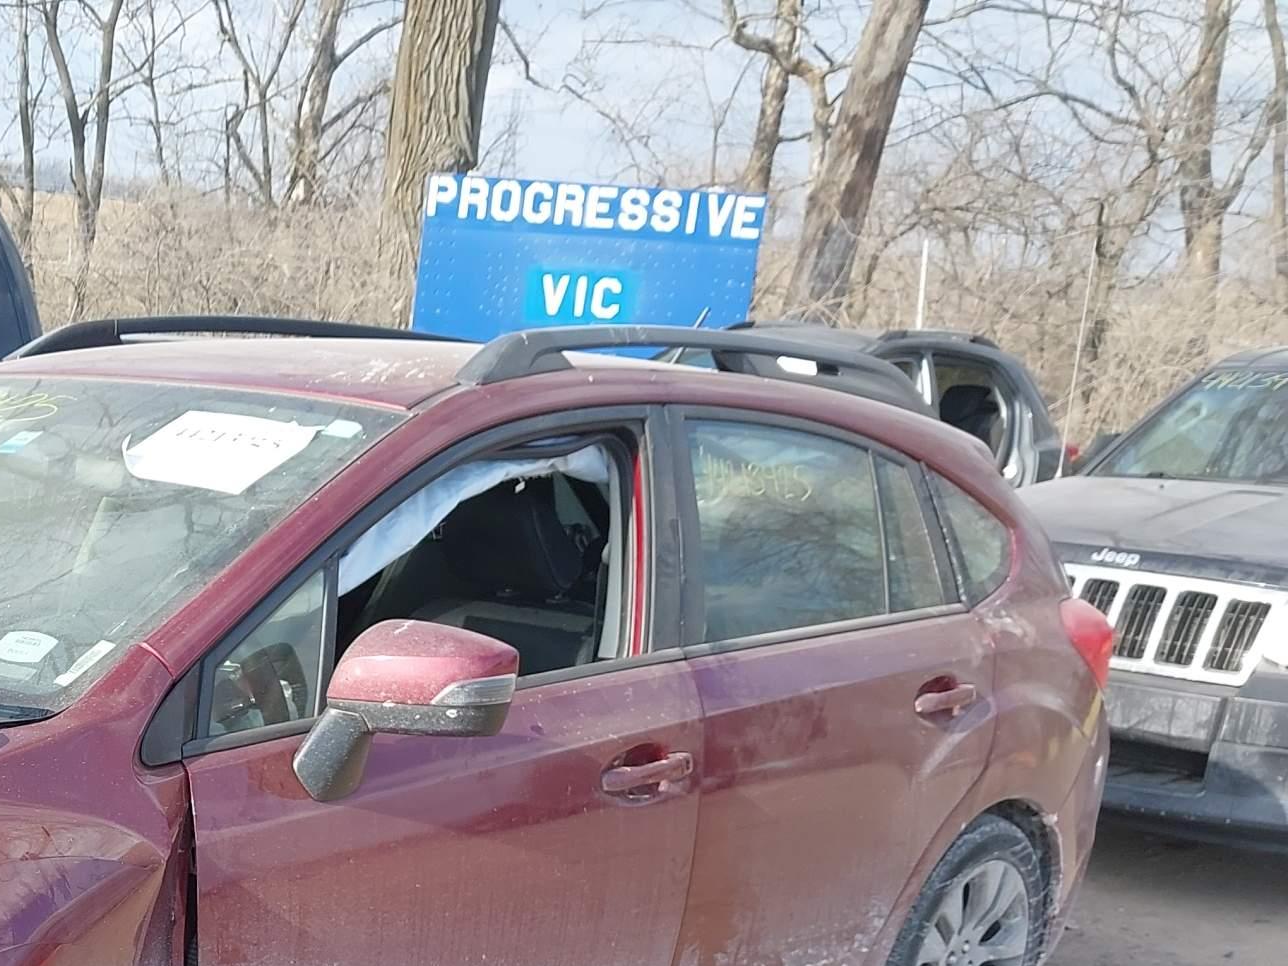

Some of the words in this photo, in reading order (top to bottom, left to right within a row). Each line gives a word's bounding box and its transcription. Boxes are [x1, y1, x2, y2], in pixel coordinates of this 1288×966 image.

[426, 174, 767, 240] PROGRESSIVE
[541, 272, 623, 320] VIC
[1090, 547, 1141, 568] Jeep
